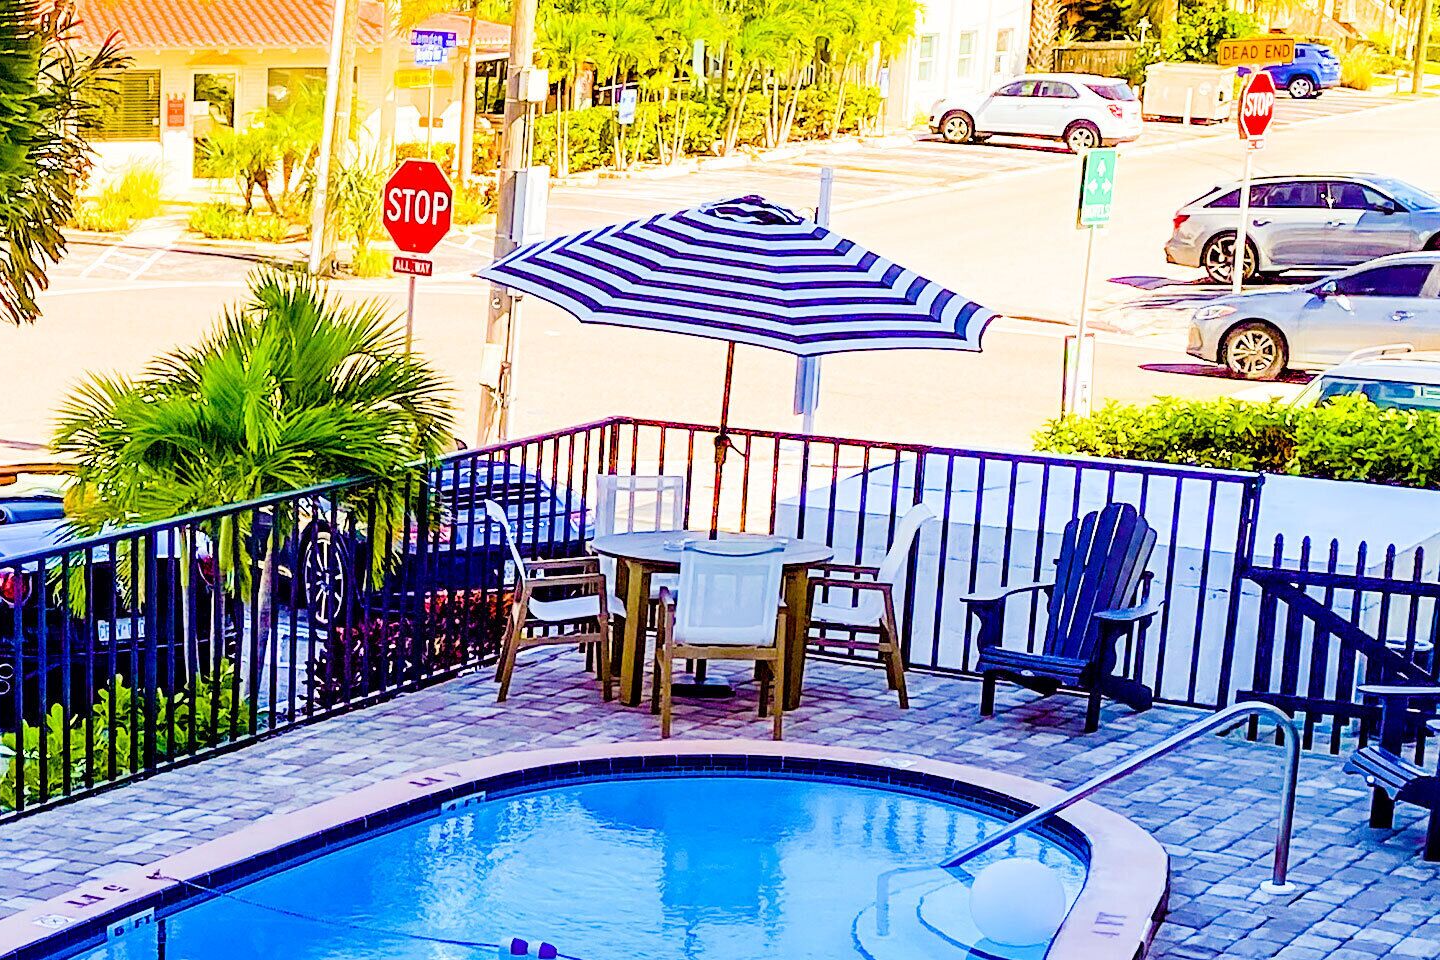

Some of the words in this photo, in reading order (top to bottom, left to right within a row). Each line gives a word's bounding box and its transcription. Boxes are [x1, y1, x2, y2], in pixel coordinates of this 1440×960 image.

[1223, 45, 1259, 60] DEAD
[1265, 44, 1291, 59] END
[1244, 91, 1274, 117] STOP
[386, 187, 449, 225] STOP
[394, 259, 410, 272] ALL
[413, 261, 431, 274] WAY
